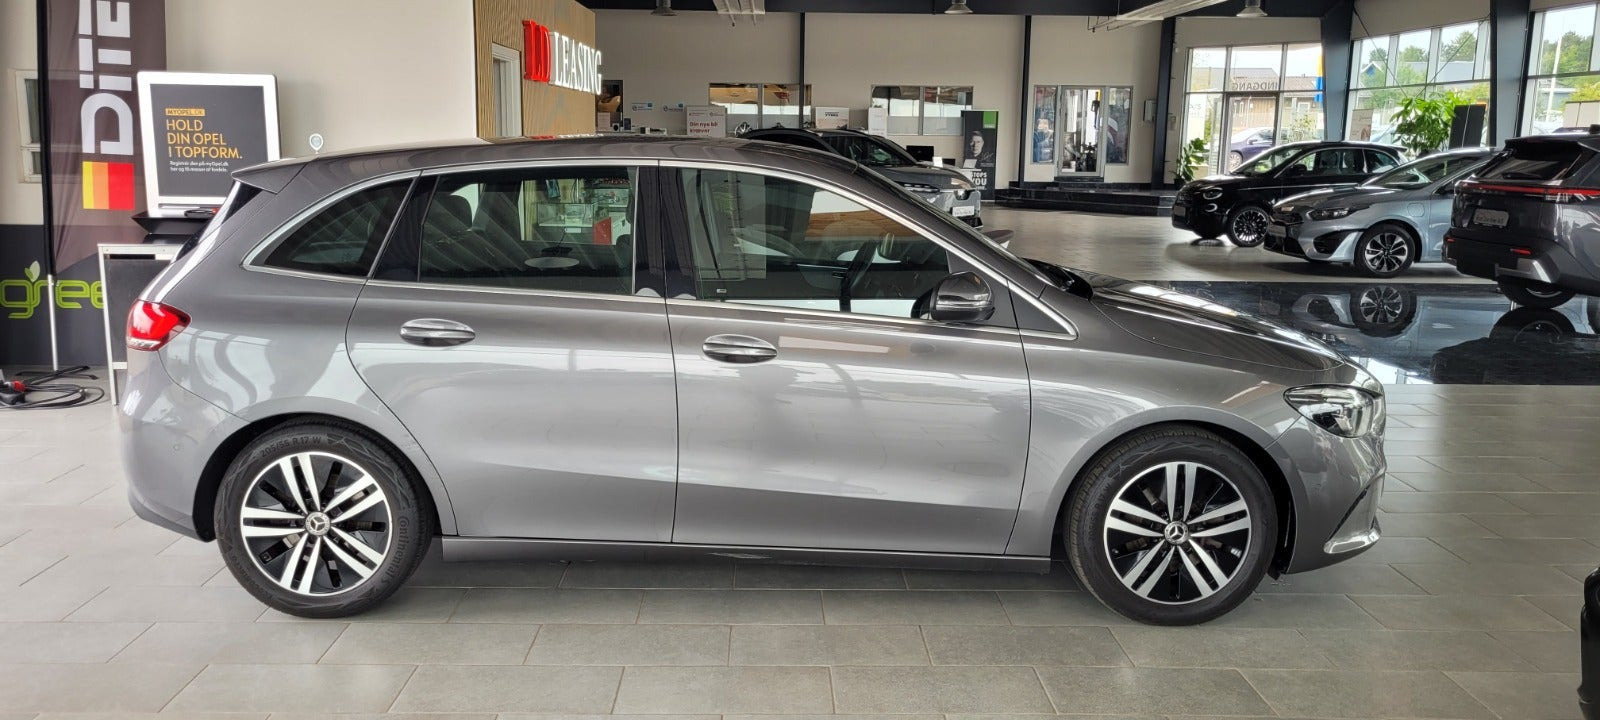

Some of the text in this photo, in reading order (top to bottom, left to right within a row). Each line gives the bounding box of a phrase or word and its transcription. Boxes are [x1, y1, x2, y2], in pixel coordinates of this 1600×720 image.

[552, 31, 602, 95] LEASING
[166, 119, 203, 131] HOLD
[167, 132, 227, 145] DIN OPEL
[168, 146, 243, 159] I TOPFORM.
[384, 515, 410, 577] Continental
